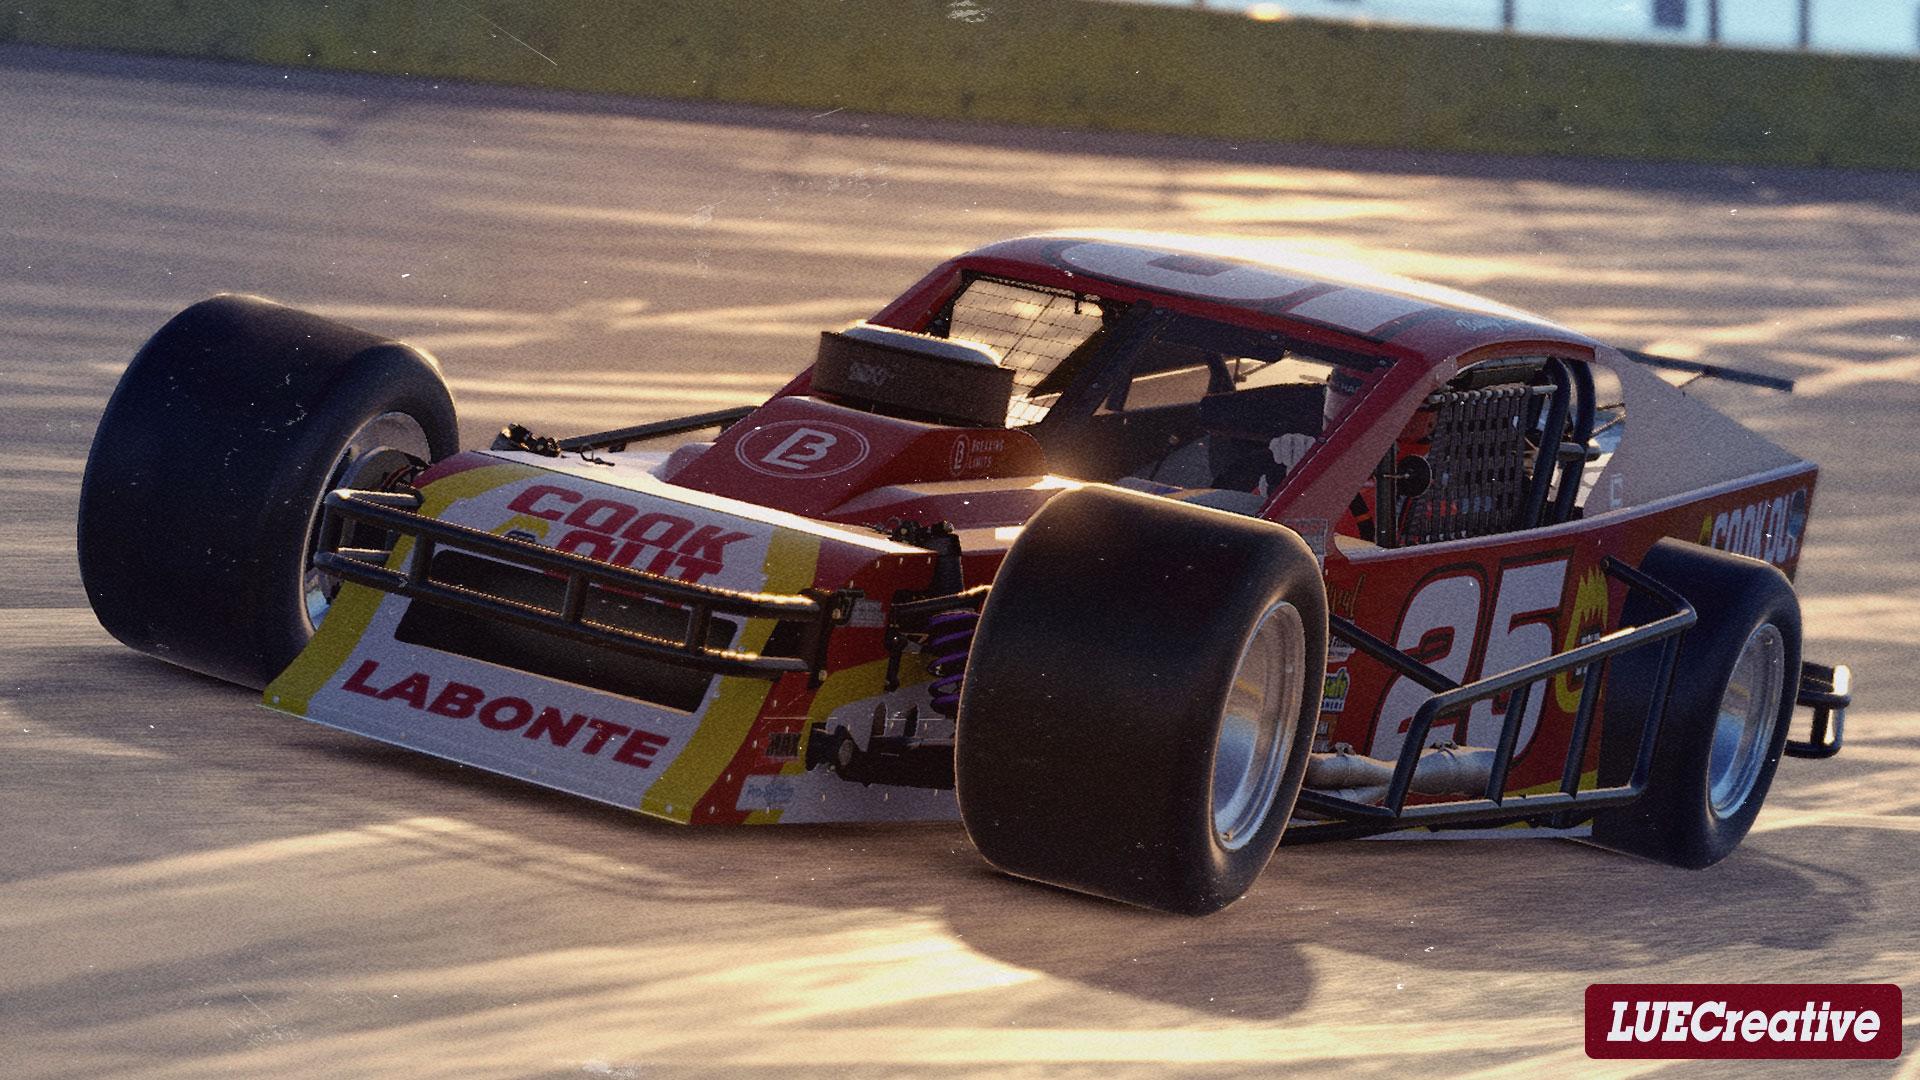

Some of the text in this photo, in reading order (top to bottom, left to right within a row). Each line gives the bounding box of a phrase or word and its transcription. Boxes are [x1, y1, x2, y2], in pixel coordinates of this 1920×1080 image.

[506, 484, 754, 564] COOK
[1711, 499, 1769, 559] COOK
[1370, 559, 1568, 763] 25
[341, 659, 670, 769] LABONTE
